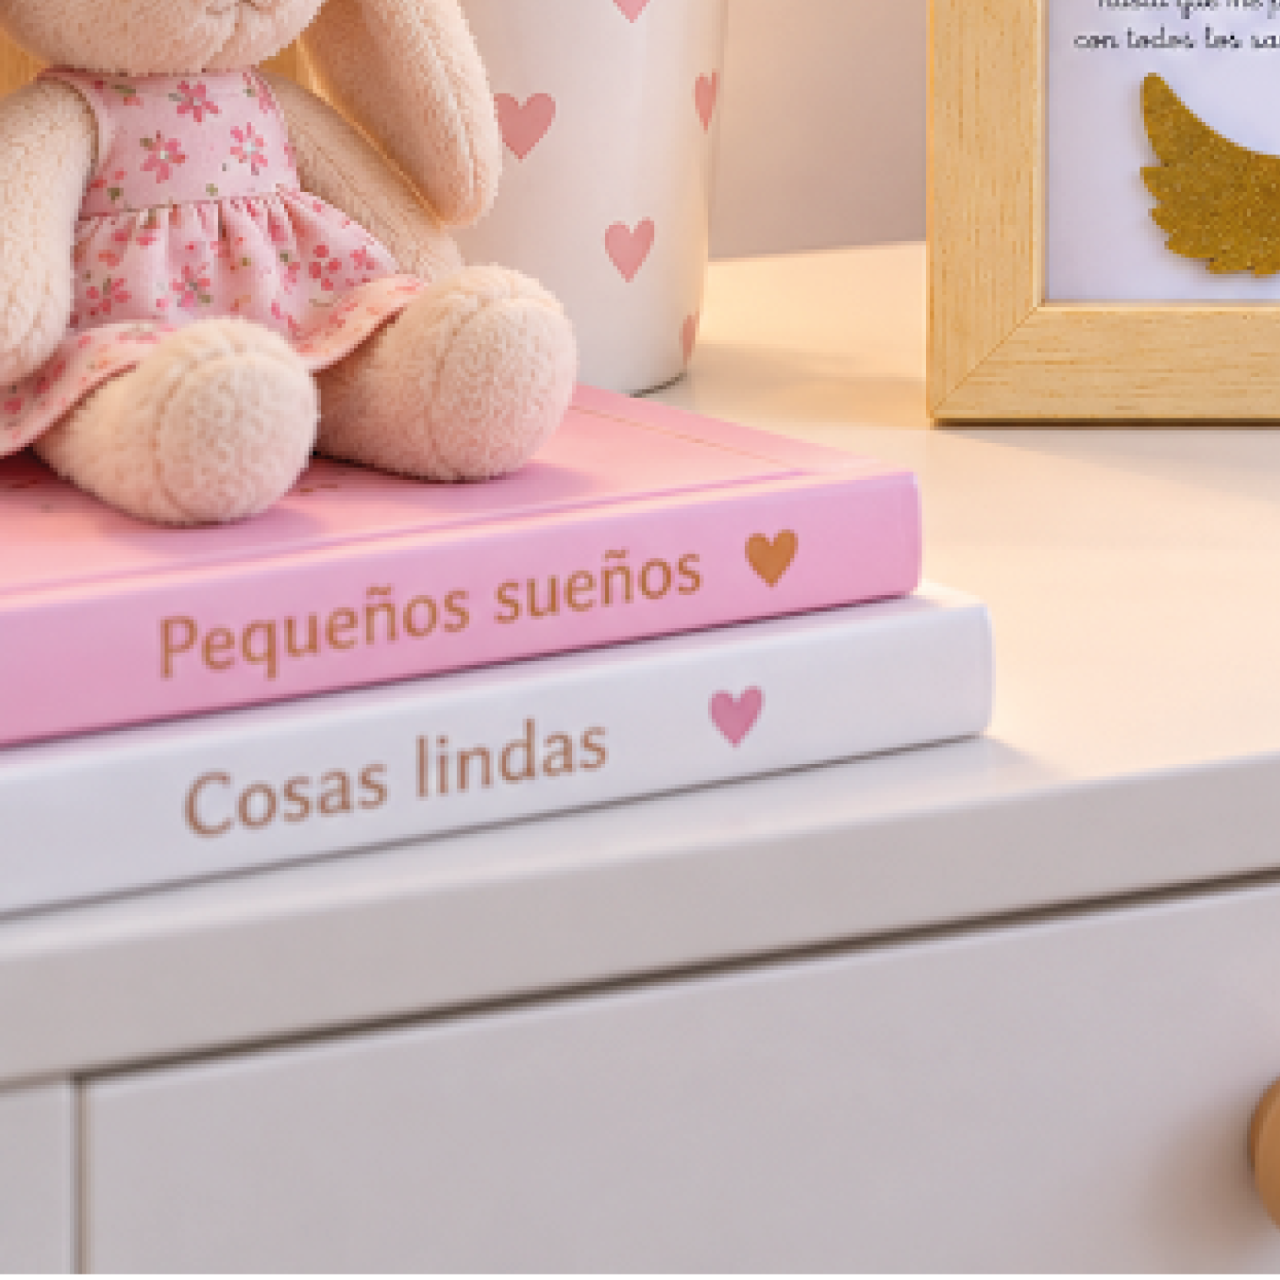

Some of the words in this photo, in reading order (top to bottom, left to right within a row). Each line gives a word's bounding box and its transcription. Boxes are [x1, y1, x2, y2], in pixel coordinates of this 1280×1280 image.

[1073, 34, 1120, 50] con
[1126, 23, 1197, 50] todos
[1204, 23, 1243, 50] los
[160, 586, 471, 681] Pequeños
[494, 549, 703, 625] sueños
[184, 761, 389, 838] Cosas
[416, 718, 609, 799] lindas
